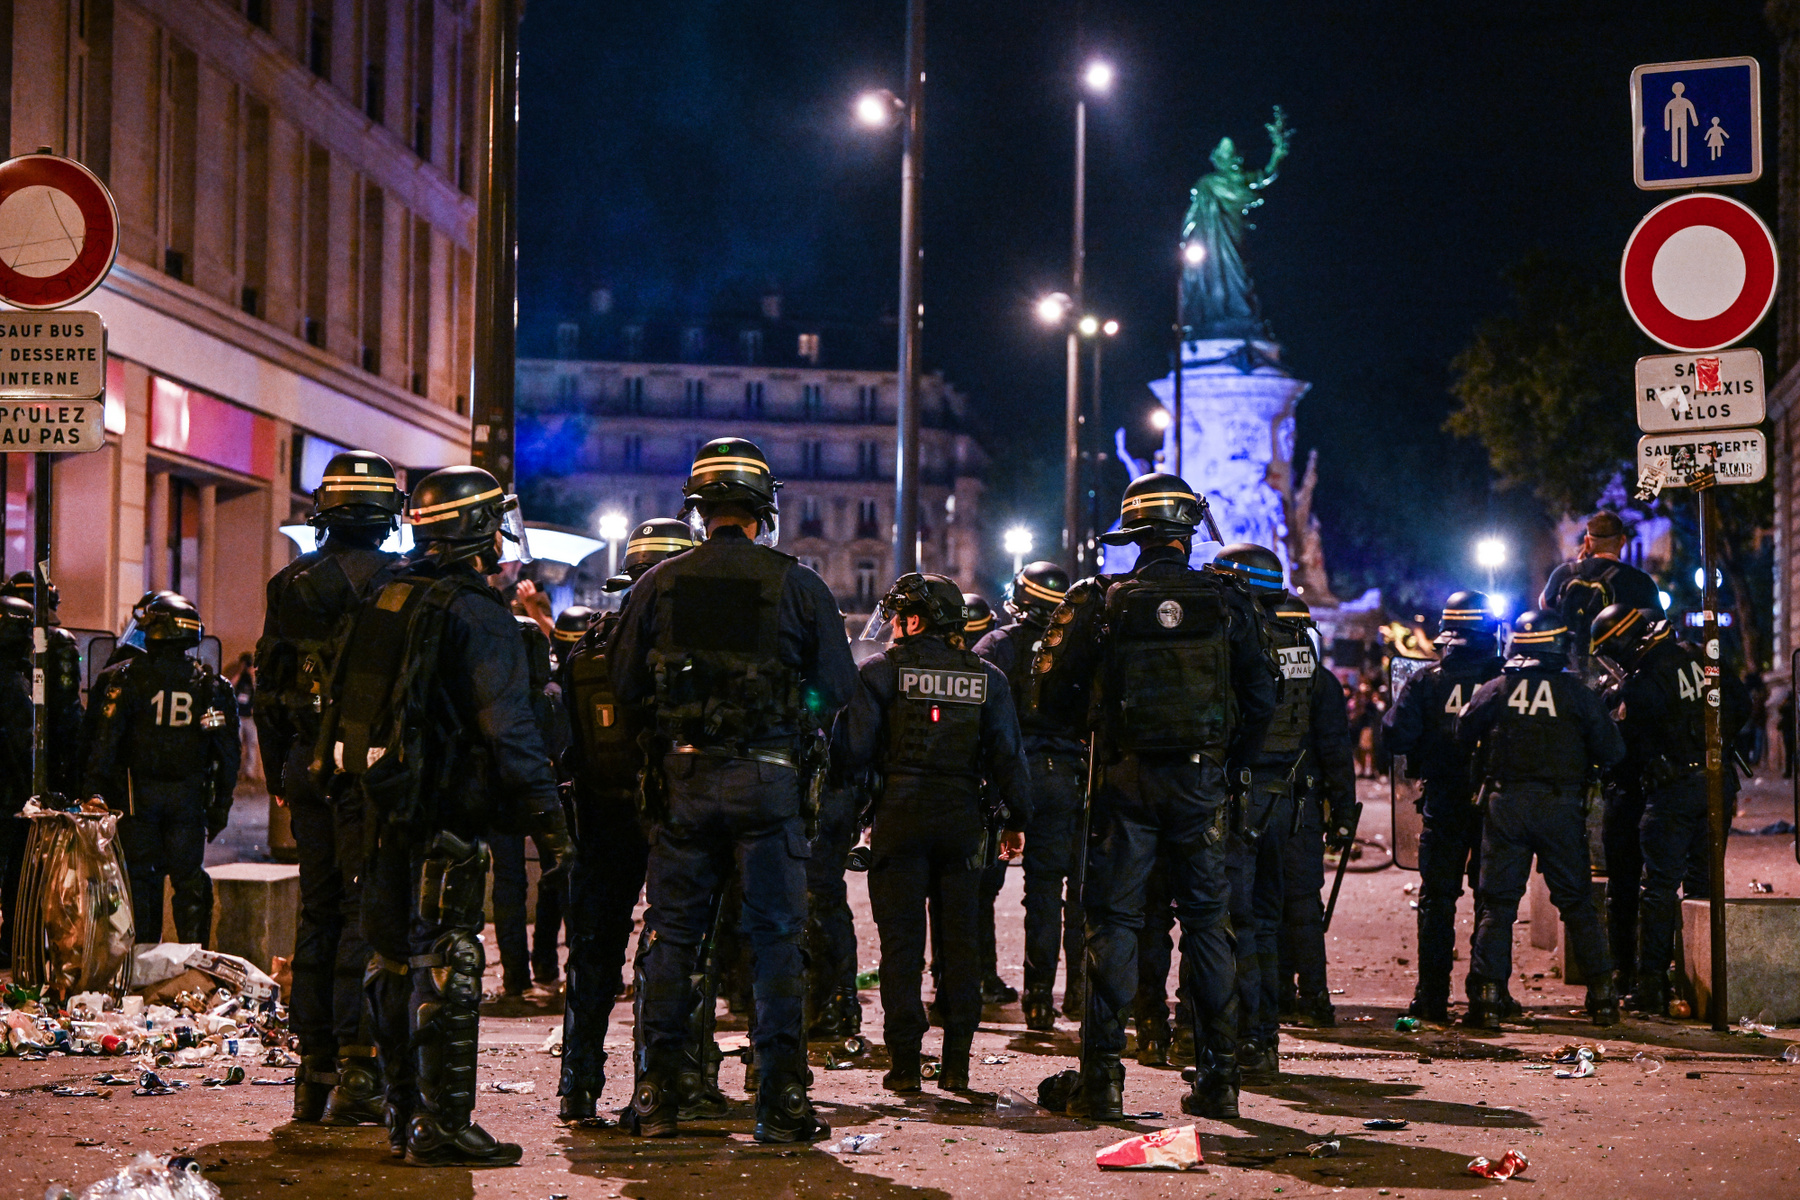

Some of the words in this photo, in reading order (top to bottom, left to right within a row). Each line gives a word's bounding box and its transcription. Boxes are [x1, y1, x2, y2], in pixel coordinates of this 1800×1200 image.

[0, 324, 42, 338] SAUF
[50, 324, 84, 338] BUS
[11, 348, 96, 361] DESSERTE
[1, 372, 79, 385] INTERNE
[3, 428, 30, 444] AU
[40, 428, 80, 444] PAS
[1645, 444, 1674, 457] SAU
[1724, 462, 1752, 475] ACAB
[903, 673, 983, 699] POLICE
[1678, 661, 1706, 702] 4A
[1507, 679, 1557, 717] 4A
[151, 690, 193, 727] 1B
